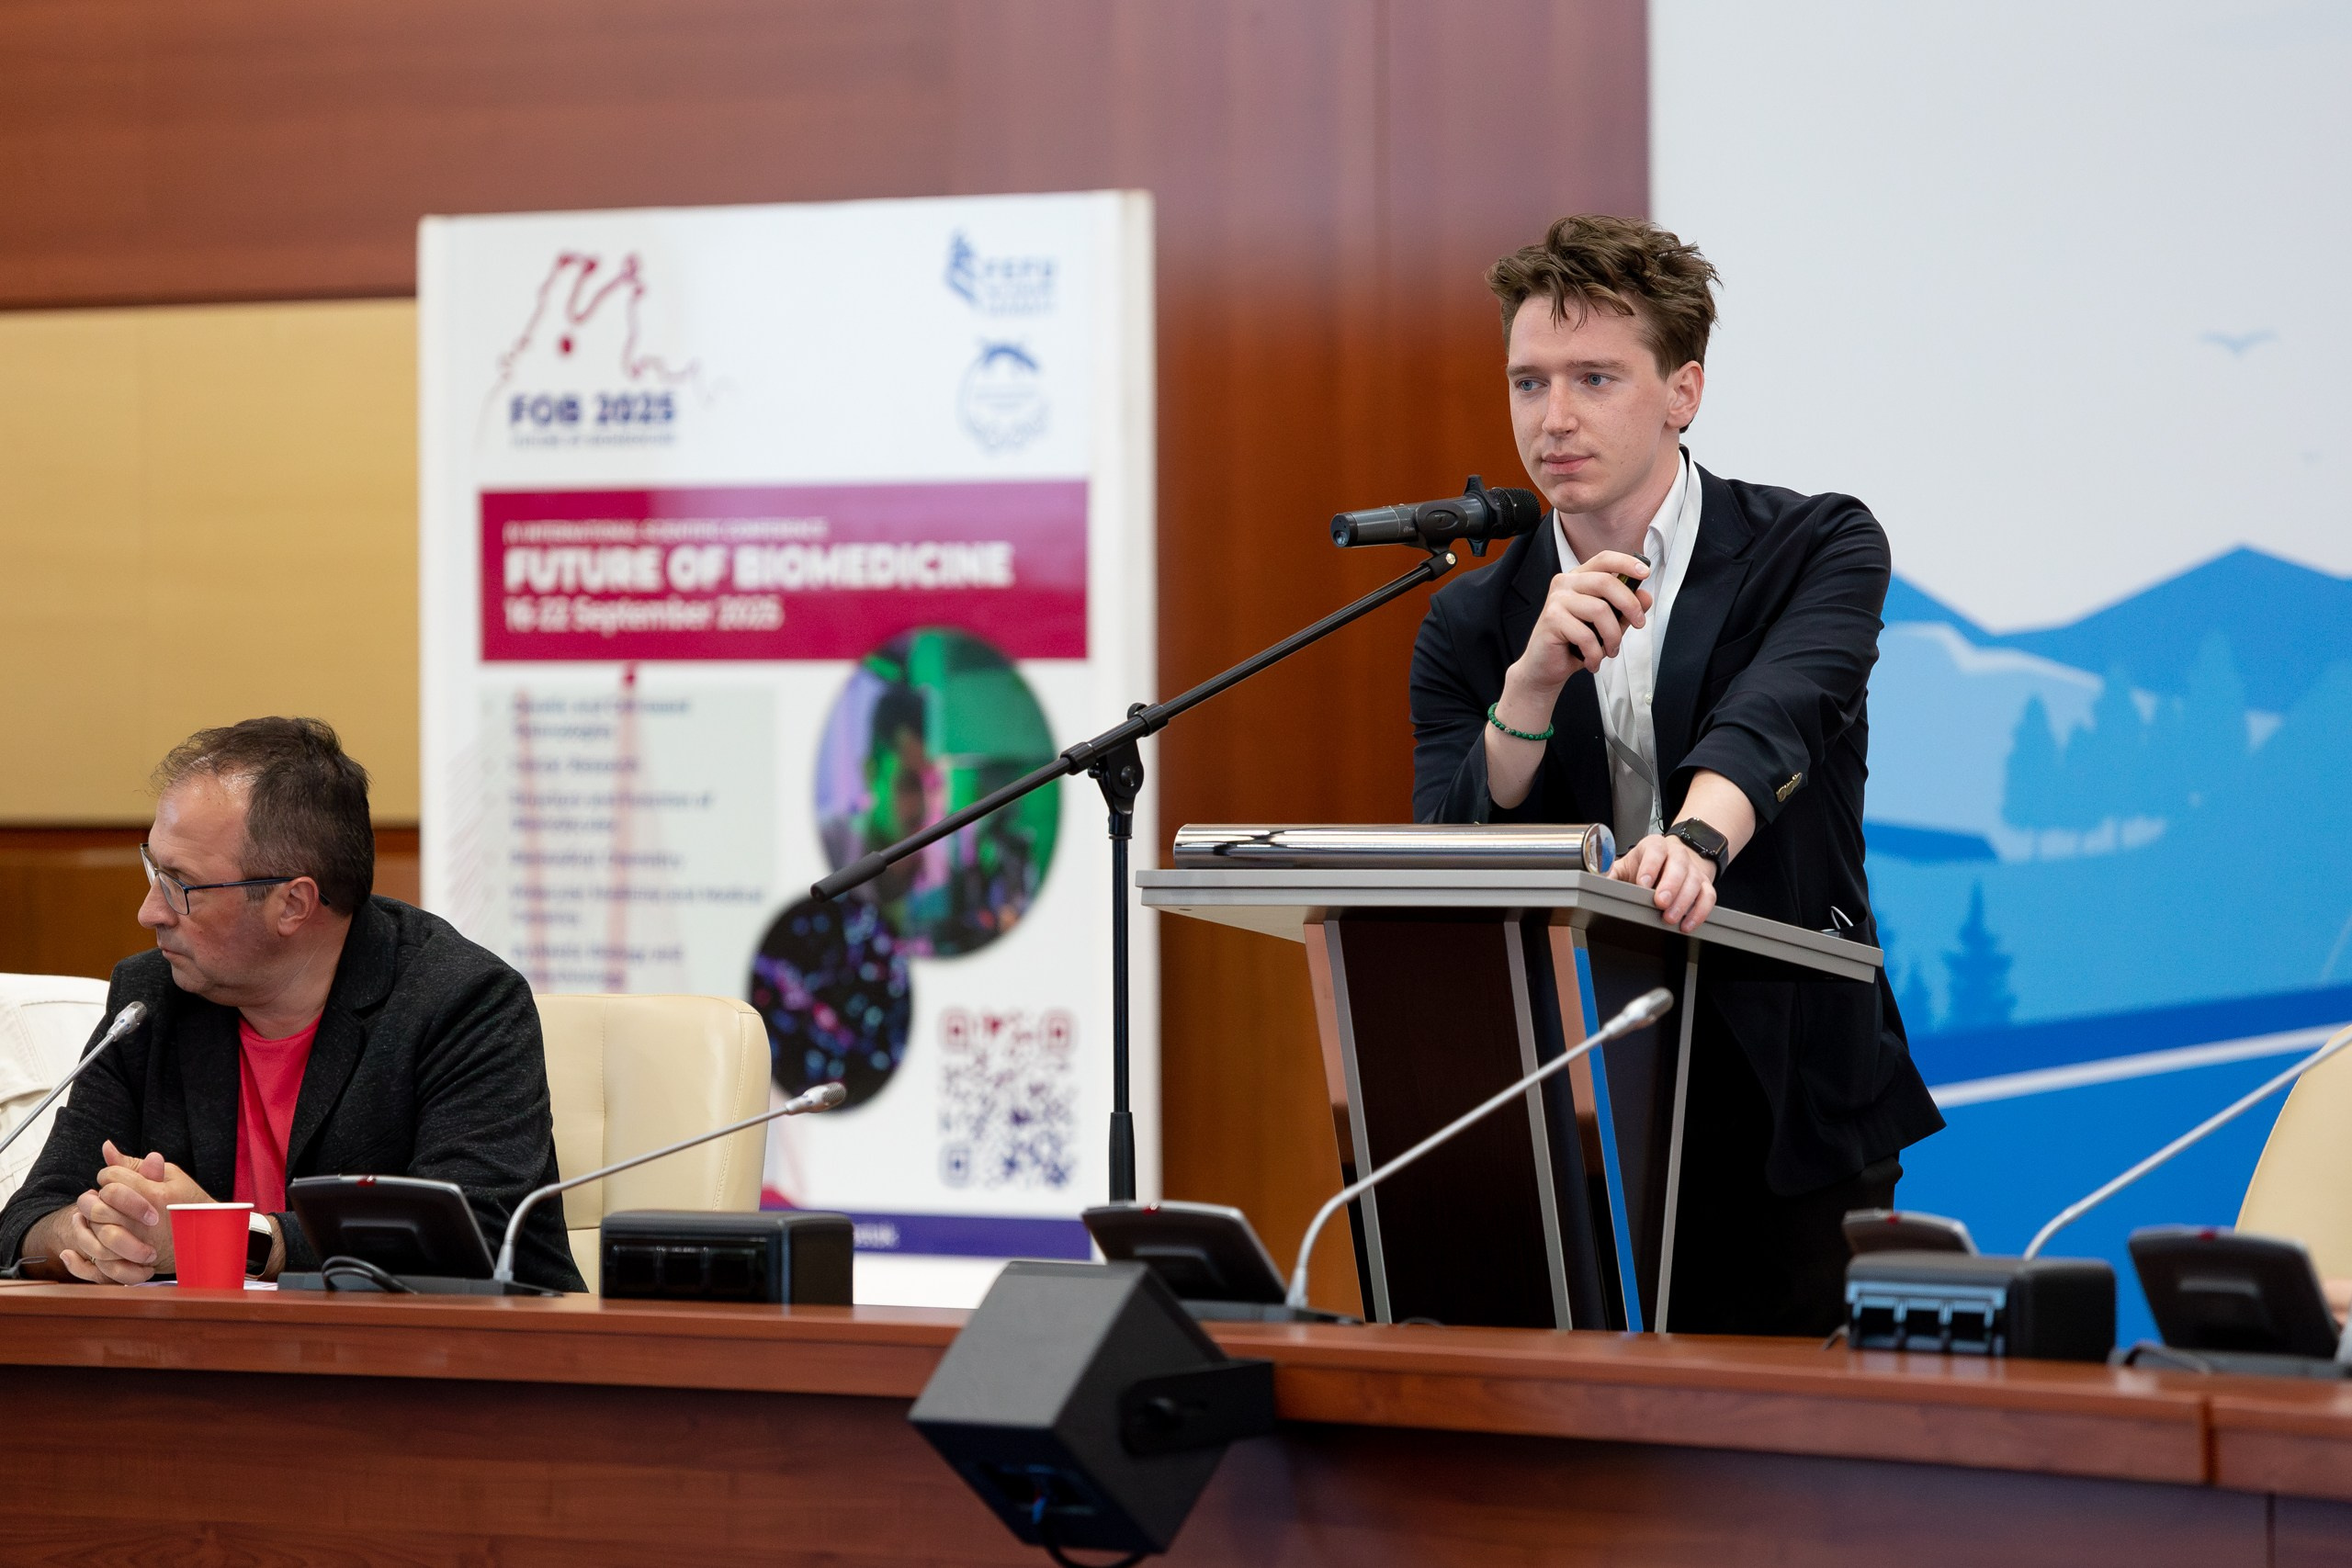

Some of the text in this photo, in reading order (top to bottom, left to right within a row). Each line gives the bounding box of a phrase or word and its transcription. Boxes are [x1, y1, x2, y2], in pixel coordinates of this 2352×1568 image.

[509, 393, 677, 427] FOB 2025
[504, 543, 1013, 592] FUTURE OF BIOMEDICINE
[573, 596, 713, 637] September
[717, 596, 783, 629] 2025
